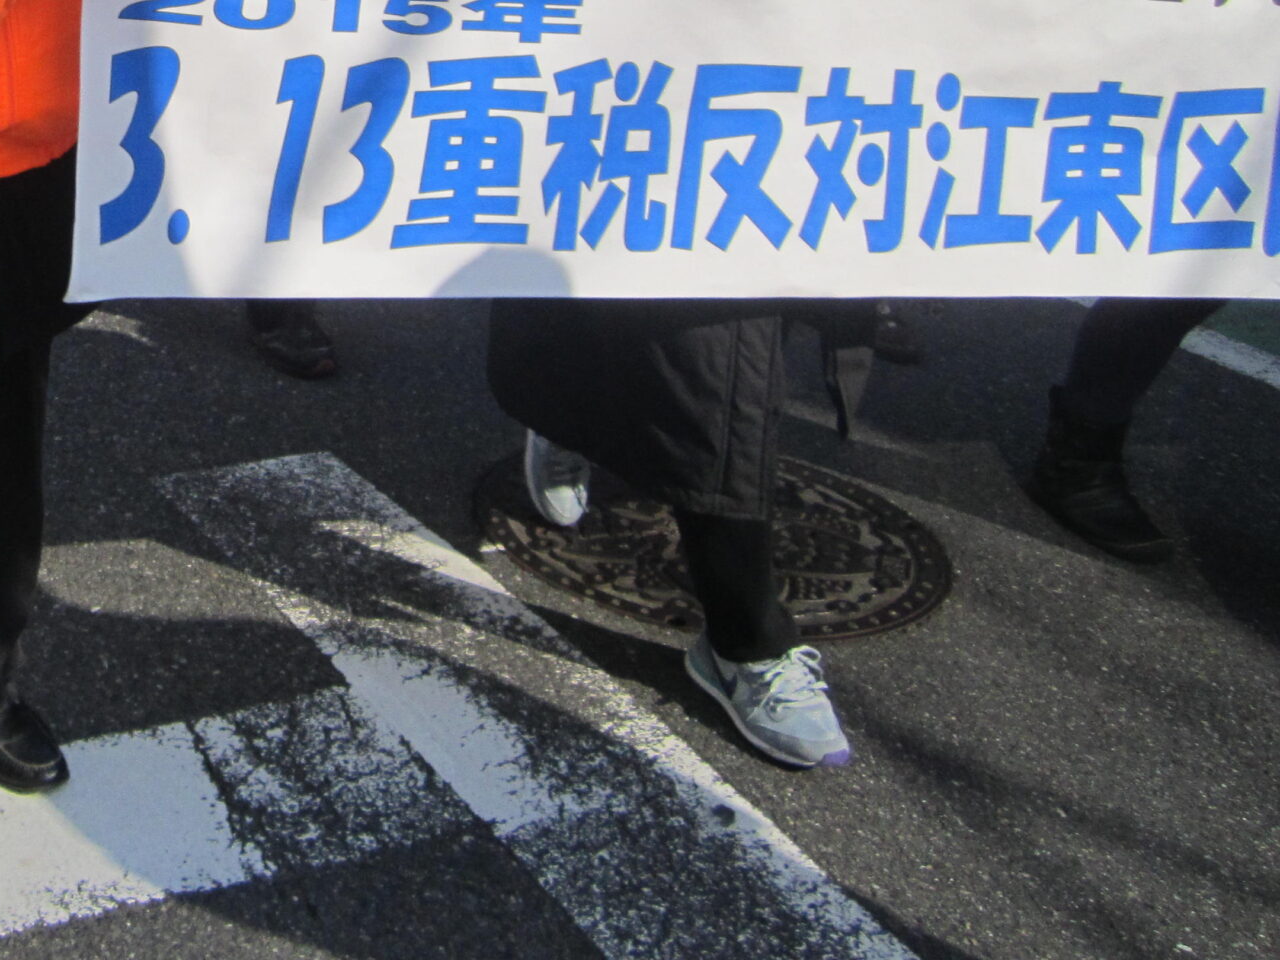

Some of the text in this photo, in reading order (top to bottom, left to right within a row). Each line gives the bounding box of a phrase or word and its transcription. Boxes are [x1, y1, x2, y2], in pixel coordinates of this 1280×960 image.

[98, 45, 1280, 257] 3.13重税反対江東区
